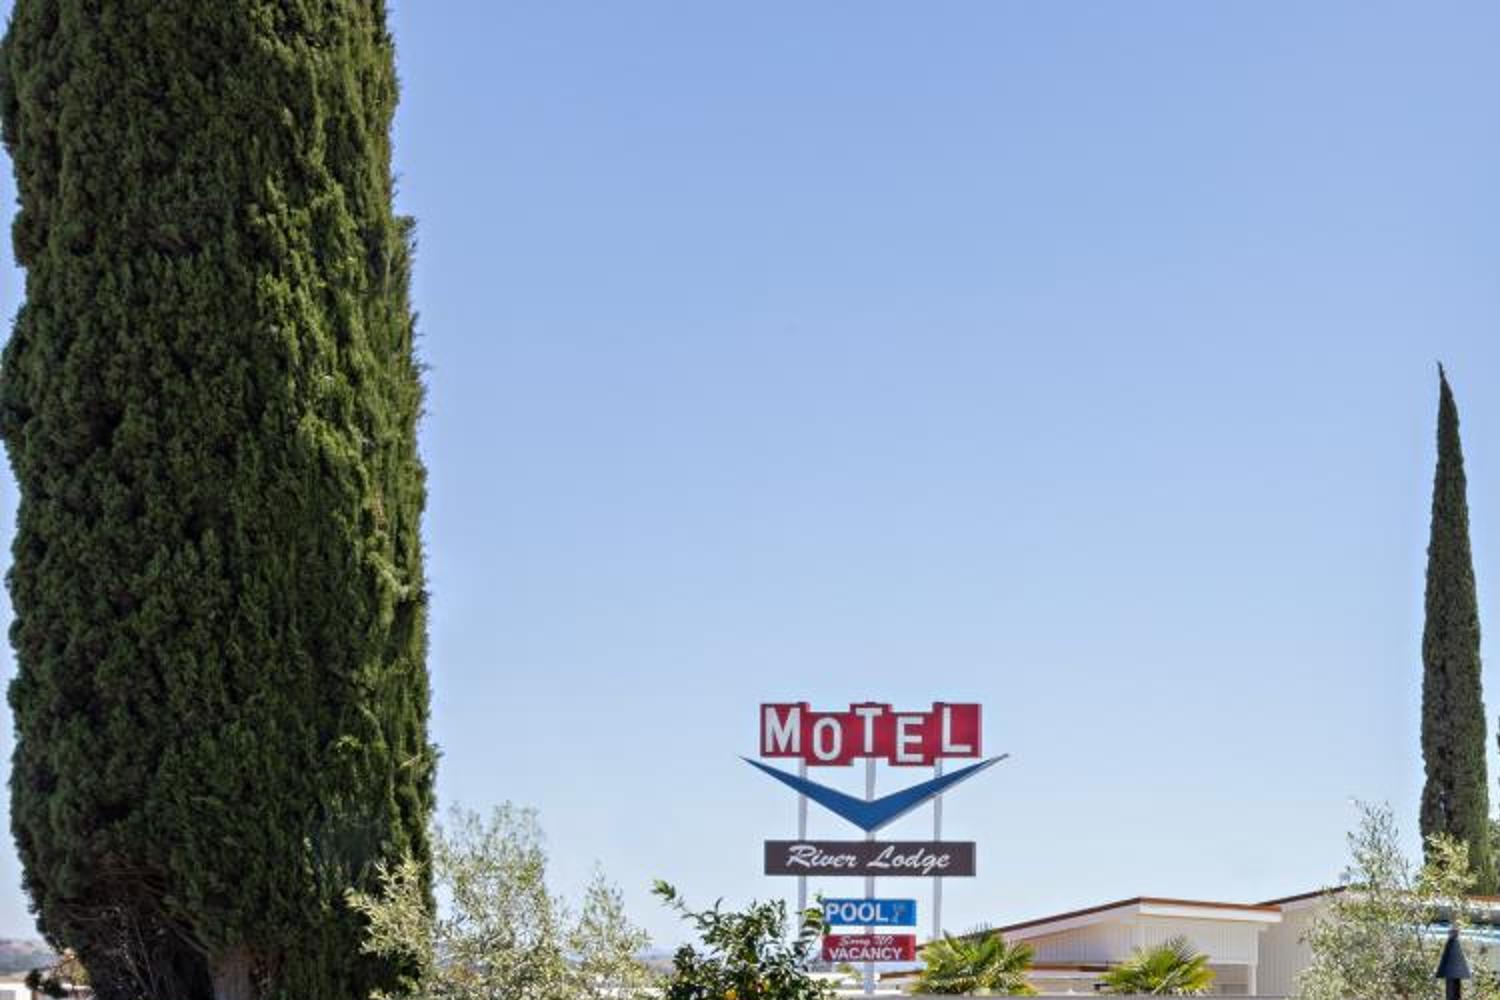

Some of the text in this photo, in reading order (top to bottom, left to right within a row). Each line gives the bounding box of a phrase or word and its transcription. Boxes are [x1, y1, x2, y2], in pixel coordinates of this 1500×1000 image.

[765, 707, 972, 762] MOTEL
[785, 845, 951, 875] River Lodge
[825, 902, 889, 923] POOL
[828, 947, 903, 961] VACANCY
